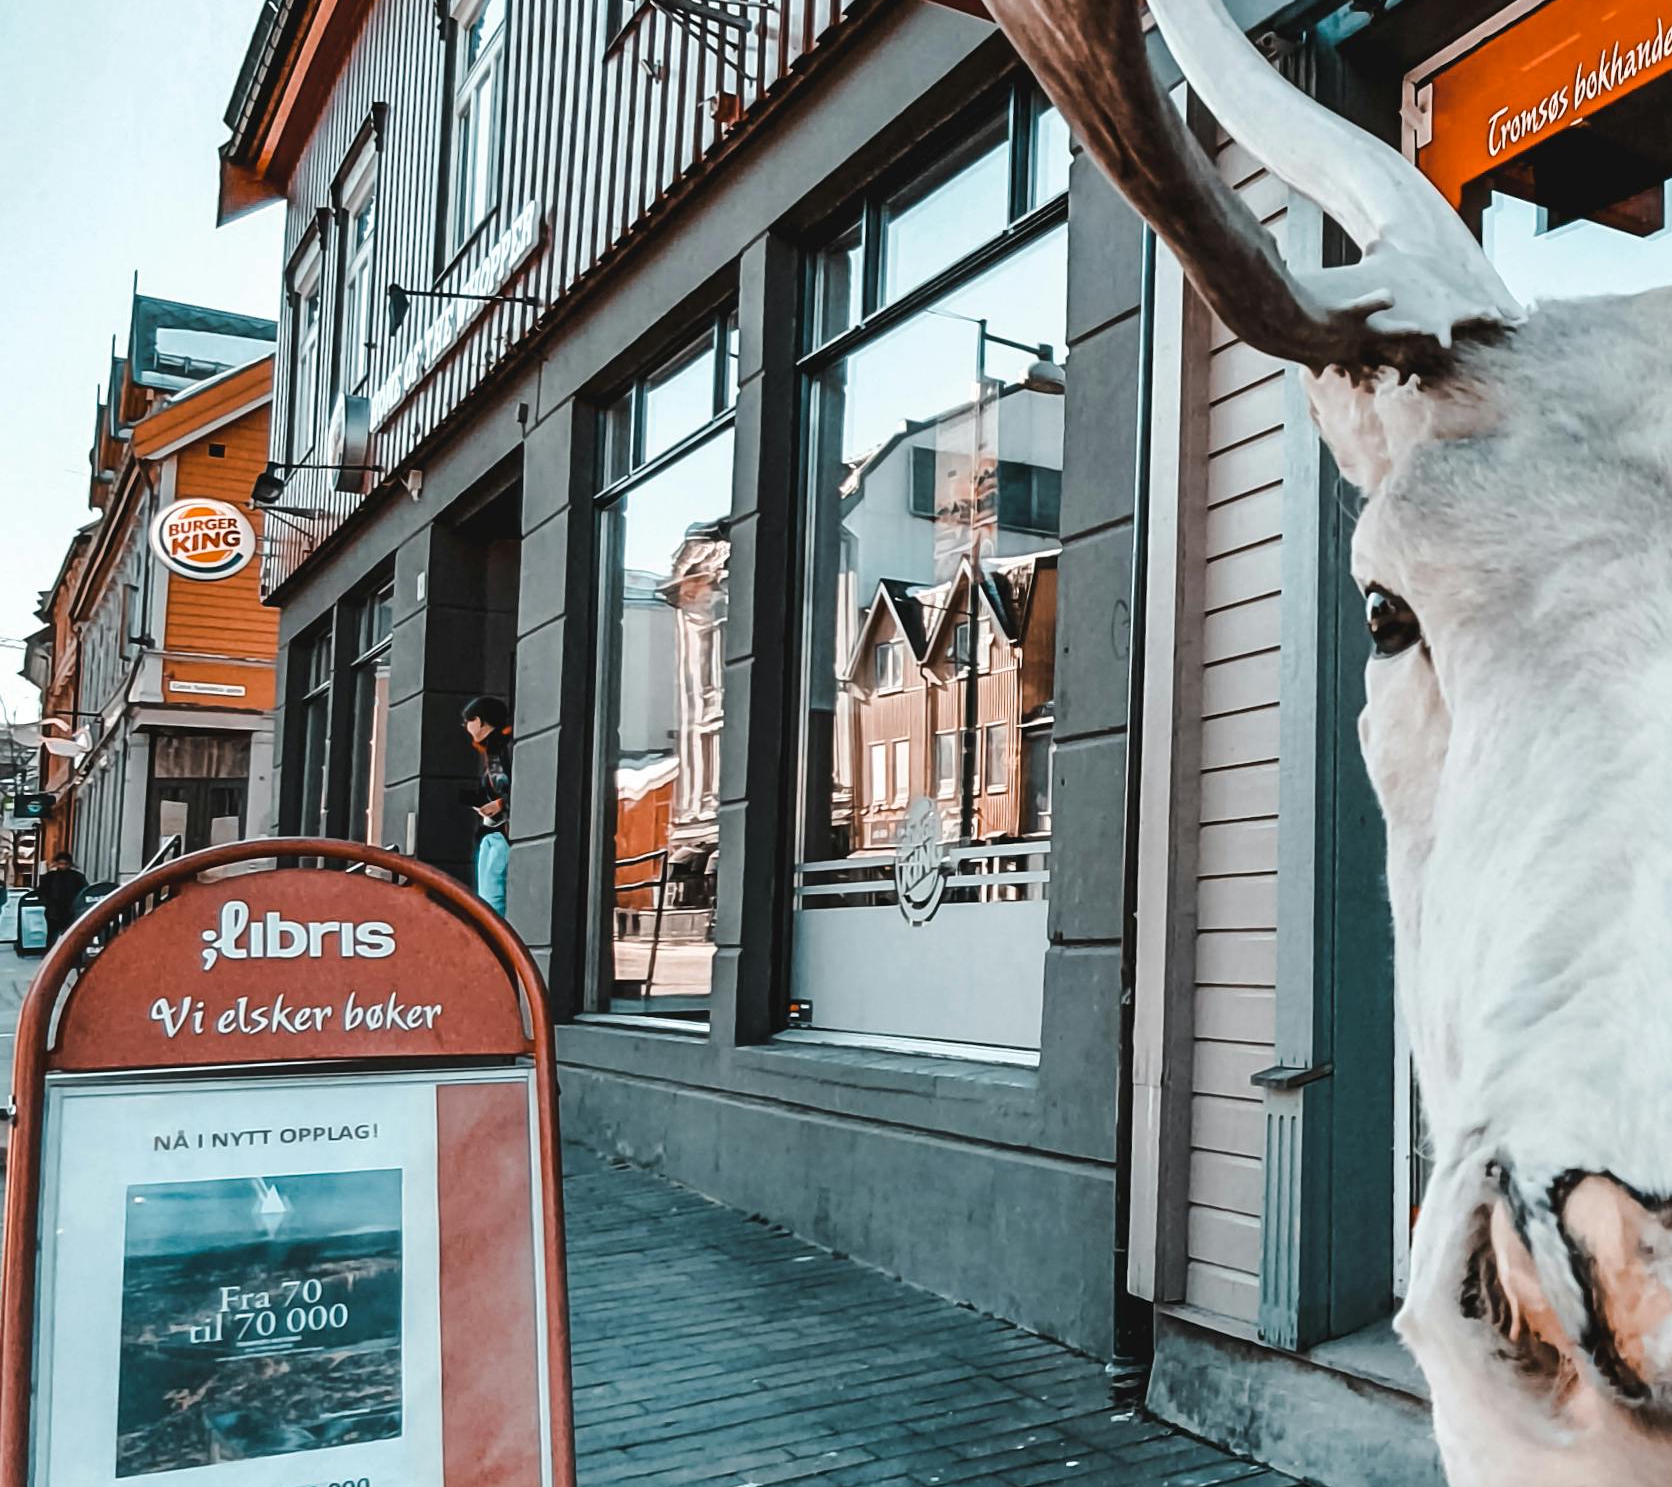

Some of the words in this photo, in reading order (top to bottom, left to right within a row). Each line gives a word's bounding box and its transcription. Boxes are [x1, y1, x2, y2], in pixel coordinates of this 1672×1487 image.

[1487, 85, 1569, 158] Tromsøs
[168, 518, 239, 537] BURGER
[171, 530, 241, 556] KING
[151, 996, 204, 1038] Vi
[217, 993, 332, 1035] elsker
[344, 991, 442, 1032] bøker
[154, 1129, 189, 1152] NÅ
[198, 1133, 204, 1149] I
[212, 1129, 272, 1148] NYTT
[280, 1123, 378, 1144] OPPLAG!
[219, 1286, 271, 1312] Fra
[281, 1278, 322, 1308] 70
[190, 1311, 223, 1344] til
[234, 1310, 276, 1341] 70
[286, 1302, 349, 1333] 000
